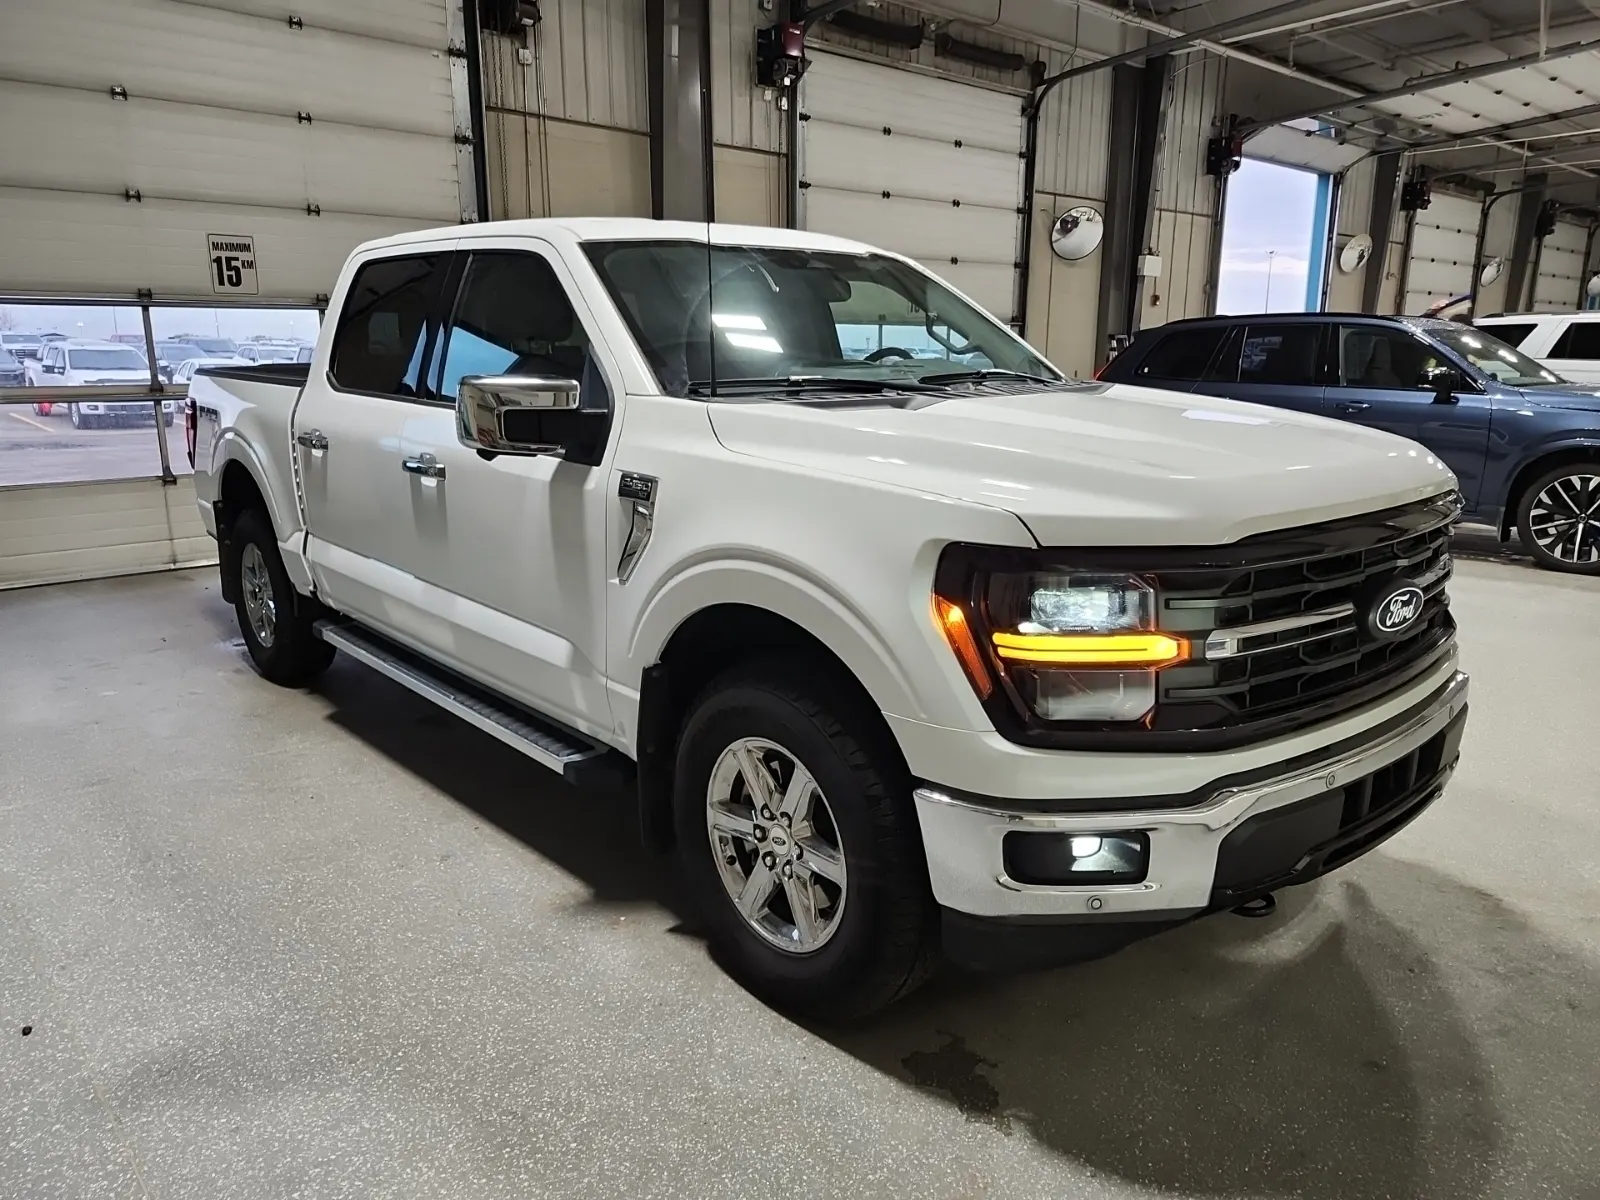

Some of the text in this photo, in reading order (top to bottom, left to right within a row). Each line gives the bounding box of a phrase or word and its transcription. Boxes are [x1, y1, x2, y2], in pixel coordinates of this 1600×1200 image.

[212, 241, 252, 253] MAXIMUM
[212, 255, 254, 288] 15 KM
[1385, 593, 1417, 627] Ford
